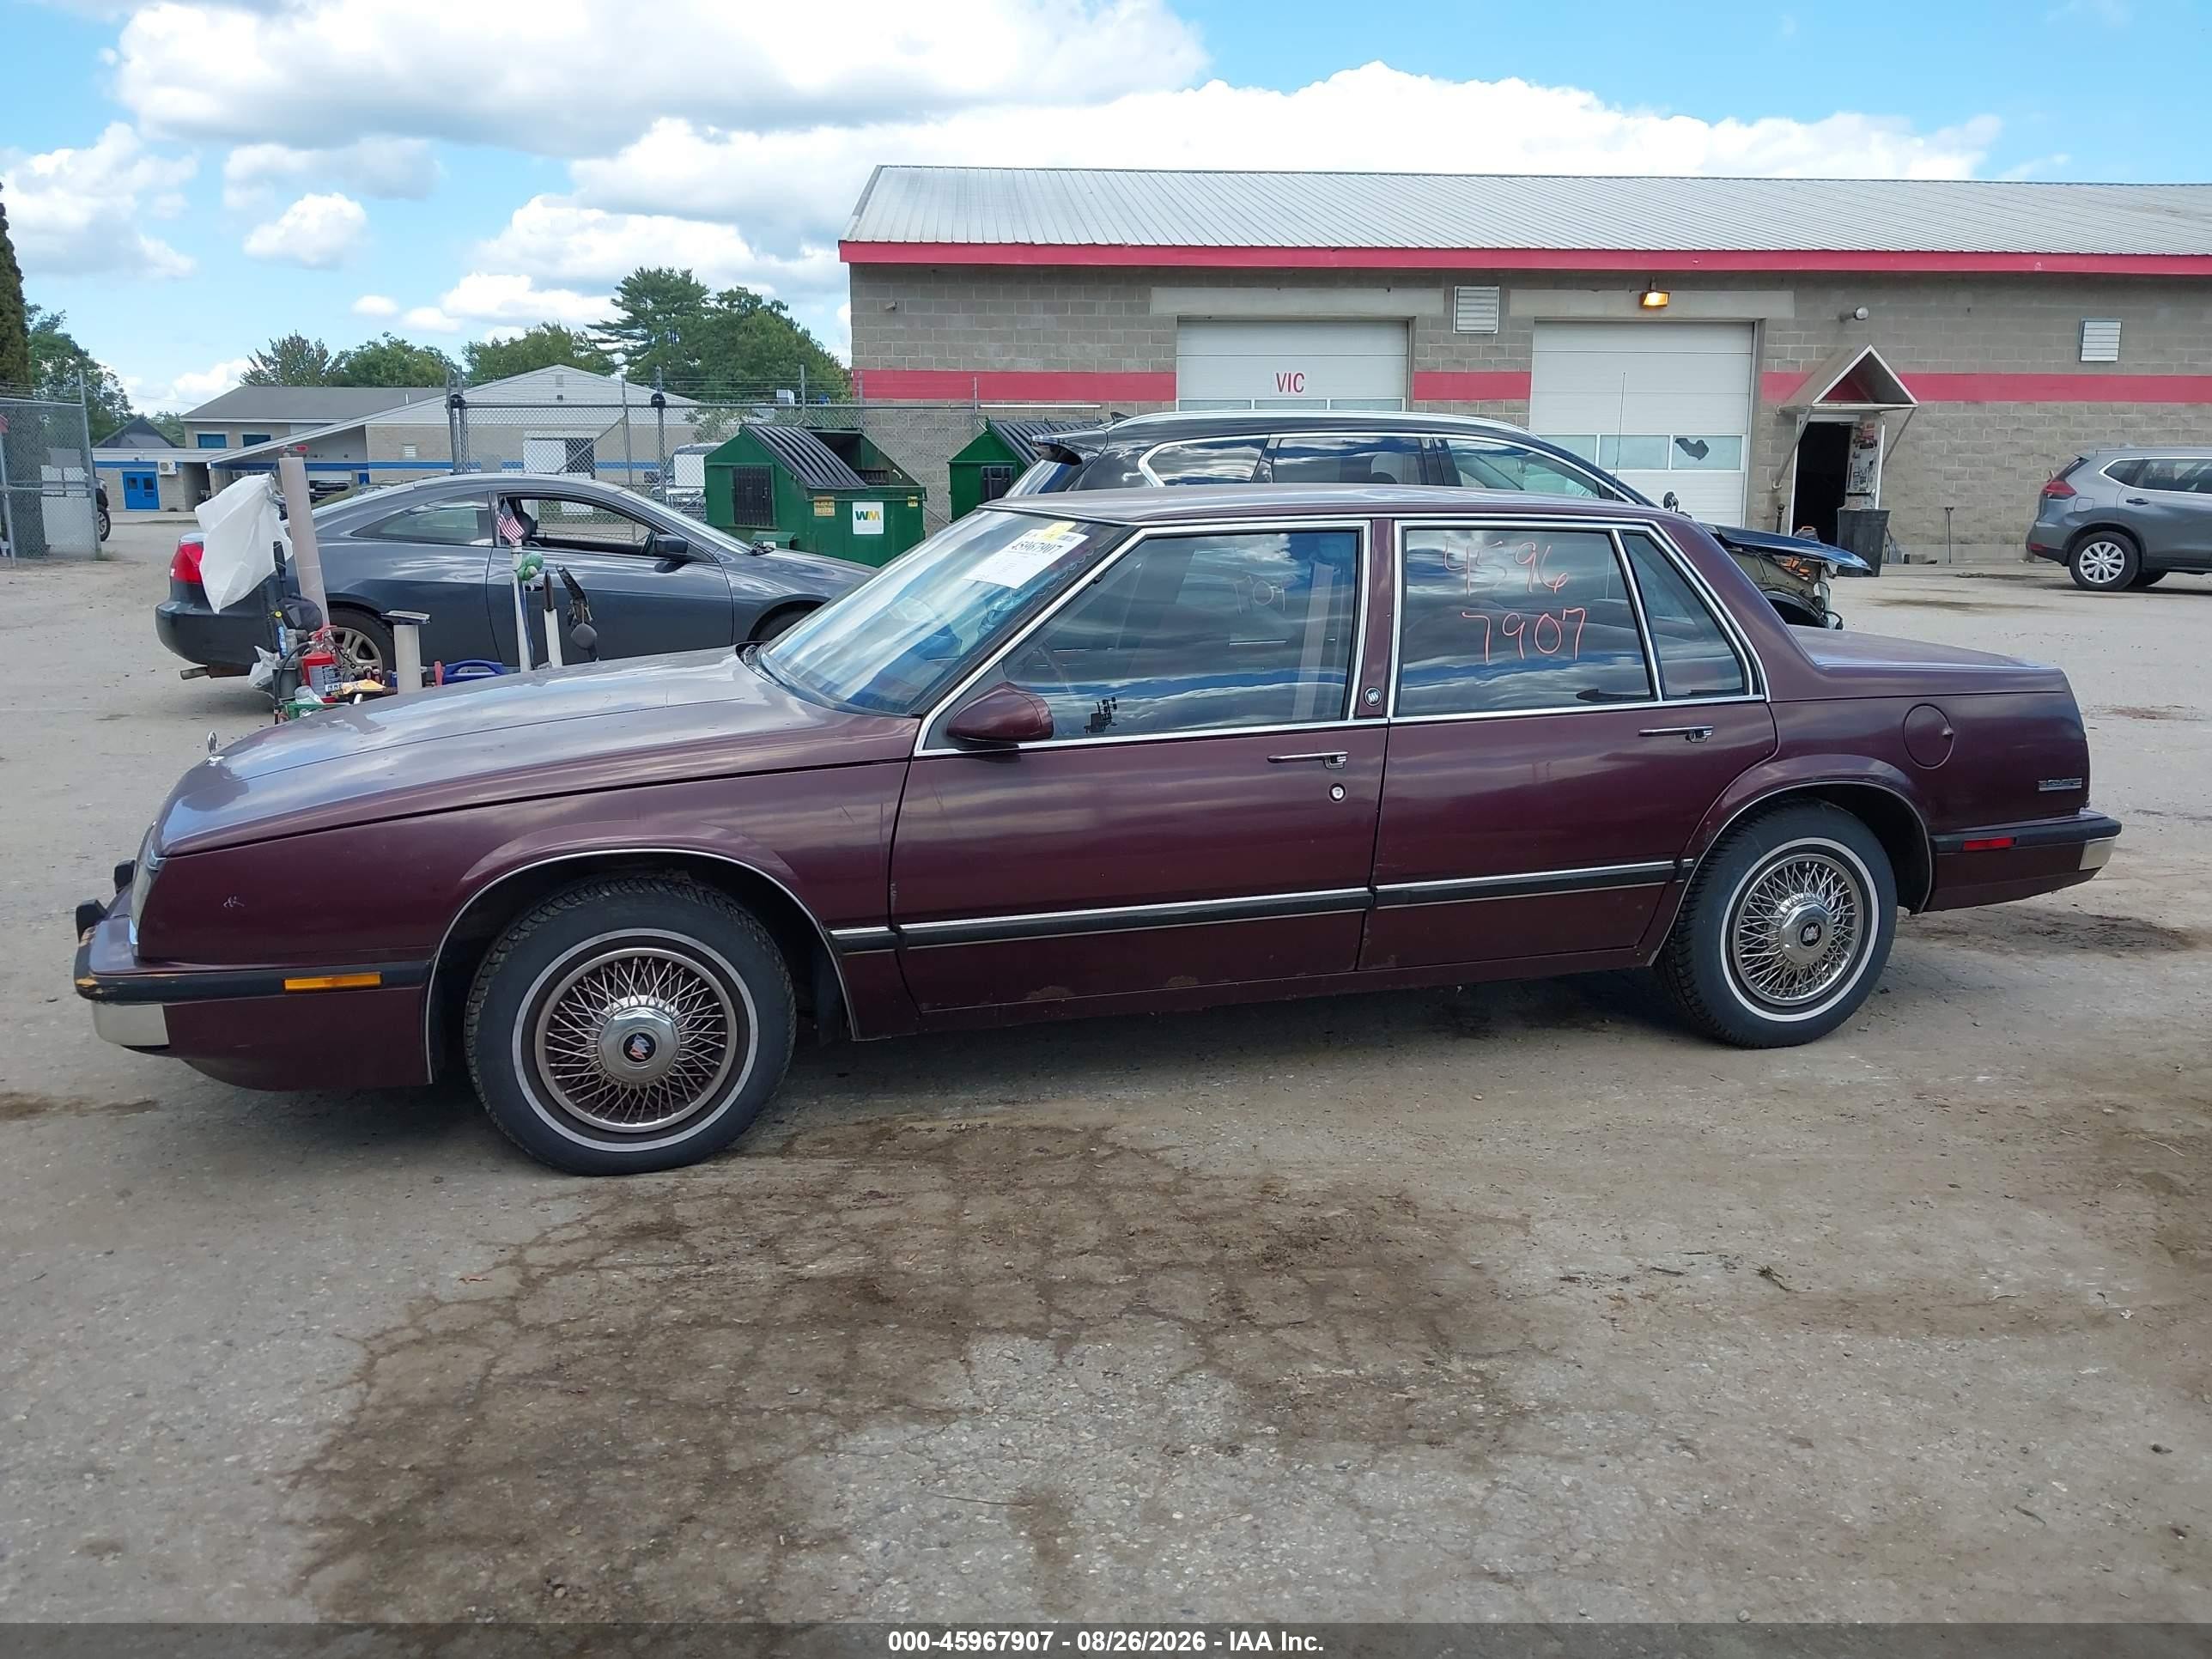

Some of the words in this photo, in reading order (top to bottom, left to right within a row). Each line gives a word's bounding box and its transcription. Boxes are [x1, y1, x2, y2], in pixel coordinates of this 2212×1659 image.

[1276, 372, 1304, 393] VIC
[855, 511, 880, 520] WM
[1443, 536, 1568, 597] 4596
[1462, 607, 1586, 665] 7907
